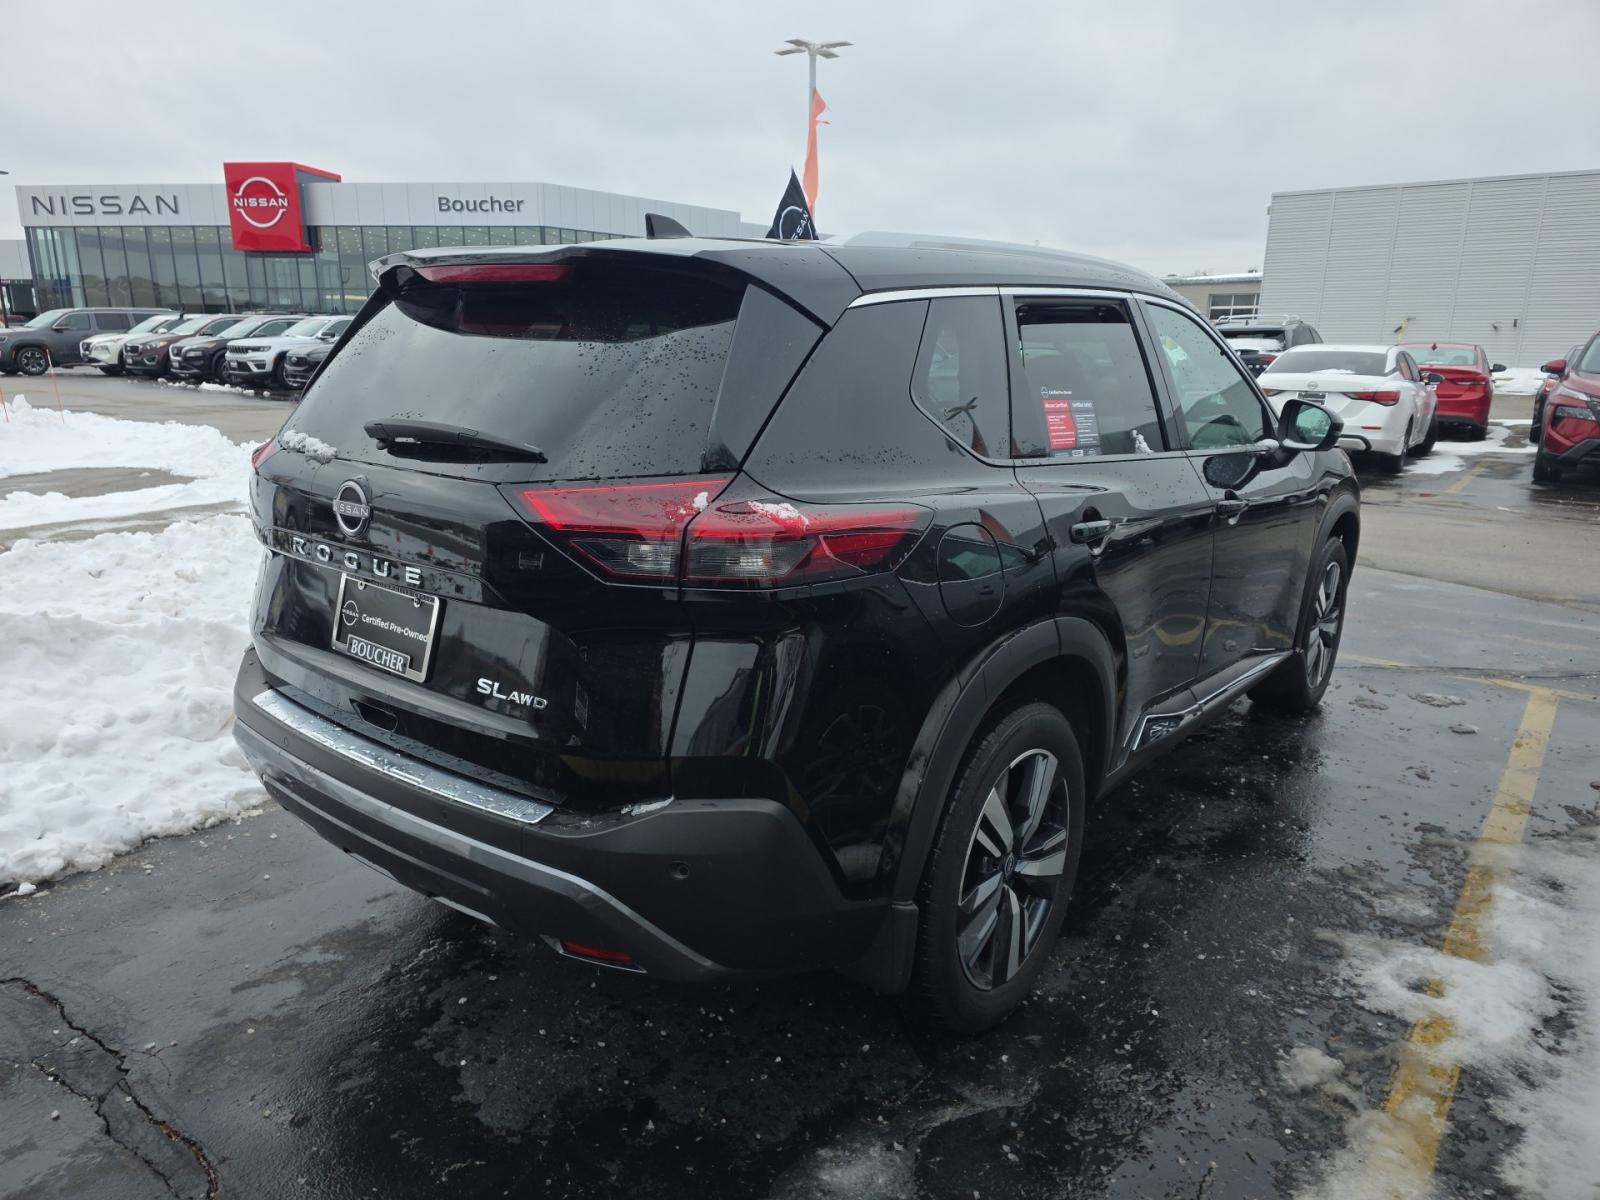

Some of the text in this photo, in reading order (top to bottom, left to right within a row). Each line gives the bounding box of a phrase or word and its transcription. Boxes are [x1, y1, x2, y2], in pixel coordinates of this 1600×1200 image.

[32, 195, 179, 215] NISSAN
[233, 196, 289, 208] NISSAN
[437, 196, 525, 213] Boucher
[292, 537, 423, 585] ROGUE
[361, 613, 390, 630] Certified
[350, 639, 405, 672] BOUCHER
[476, 677, 548, 709] SL AWD
